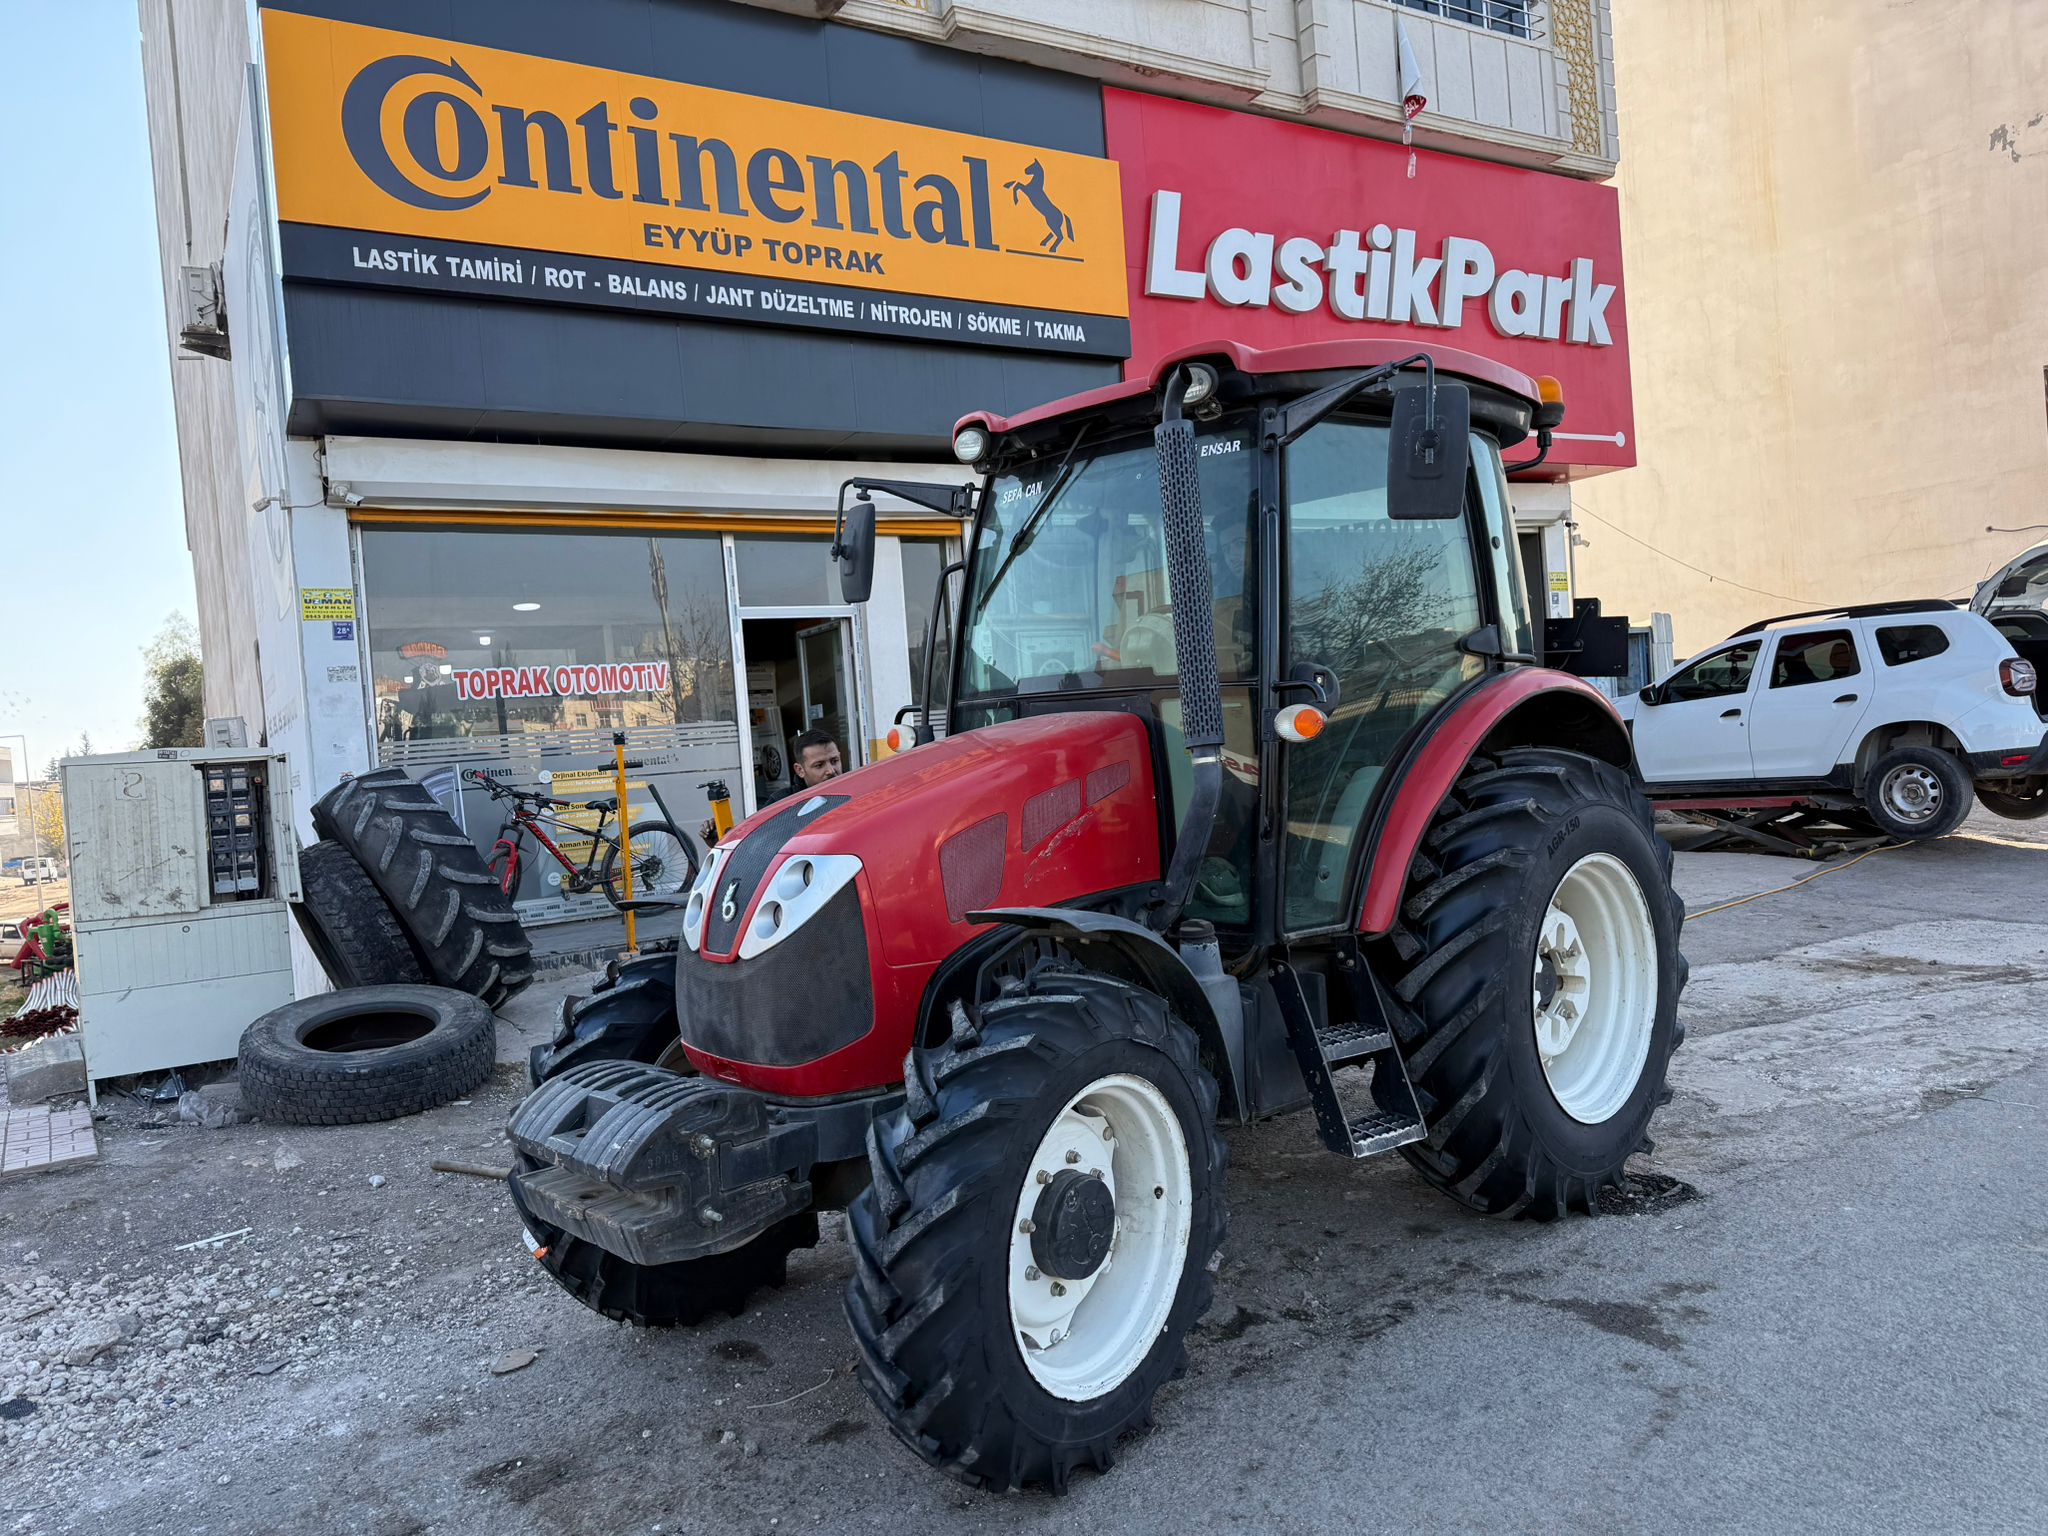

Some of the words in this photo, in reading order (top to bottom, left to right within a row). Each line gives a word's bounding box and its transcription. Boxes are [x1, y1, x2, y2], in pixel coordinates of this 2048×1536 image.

[342, 54, 1001, 252] Continental
[643, 222, 753, 258] EYYÜP
[762, 238, 885, 275] TOPRAK
[1145, 188, 1616, 345] LastikPark
[352, 246, 439, 276] LASTİK
[445, 256, 523, 284] TAMİRİ
[544, 266, 587, 290] ROT
[607, 273, 688, 301] BALANS
[705, 285, 755, 308] JANT
[760, 289, 855, 319] DÜZELTME
[870, 300, 953, 329] NİTROJEN
[967, 312, 1022, 336] SÖKME
[1034, 320, 1086, 343] TAKMA
[1200, 440, 1241, 457] ENSAR
[1026, 481, 1043, 498] CAN
[453, 668, 551, 699] TOPRAK
[552, 772, 576, 780] Orjinal
[558, 841, 582, 849] Alman
[1547, 815, 1580, 859] AGR-150
